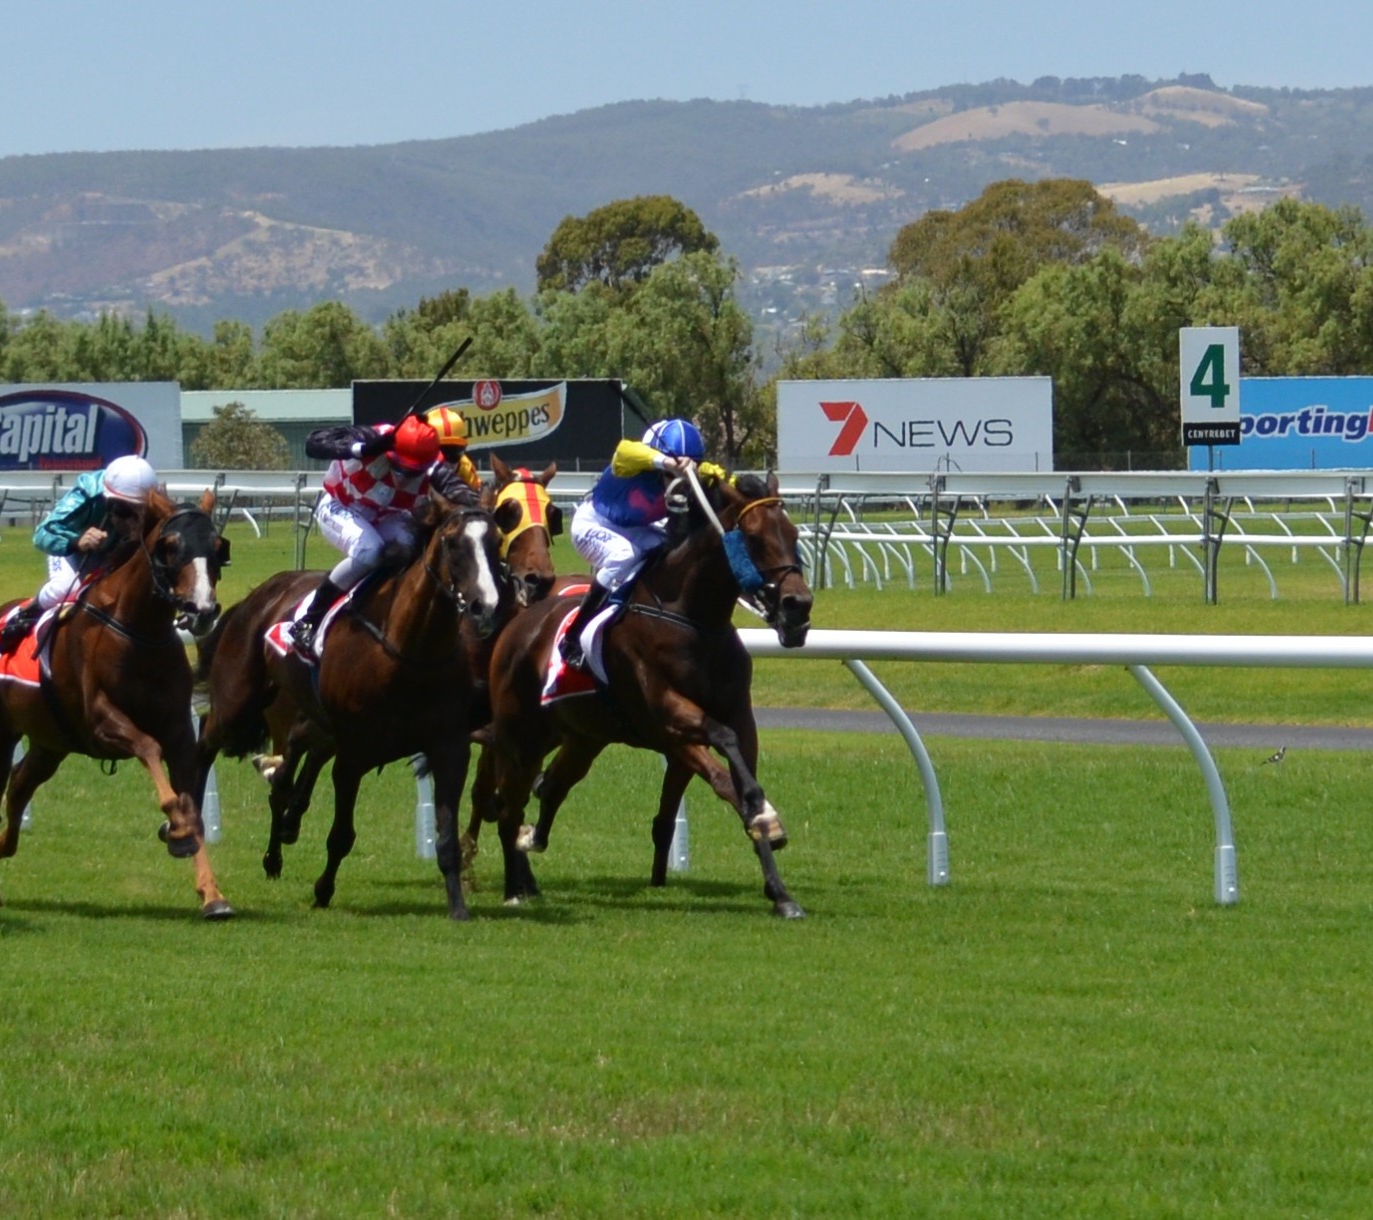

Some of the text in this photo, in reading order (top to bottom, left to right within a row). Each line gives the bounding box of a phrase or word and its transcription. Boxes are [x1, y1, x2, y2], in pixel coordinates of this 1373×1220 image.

[1190, 344, 1230, 408] 4
[461, 403, 551, 438] hweppes
[818, 401, 1014, 457] 7 NEWS
[1187, 428, 1236, 440] CENTREBET
[1240, 407, 1373, 441] porting
